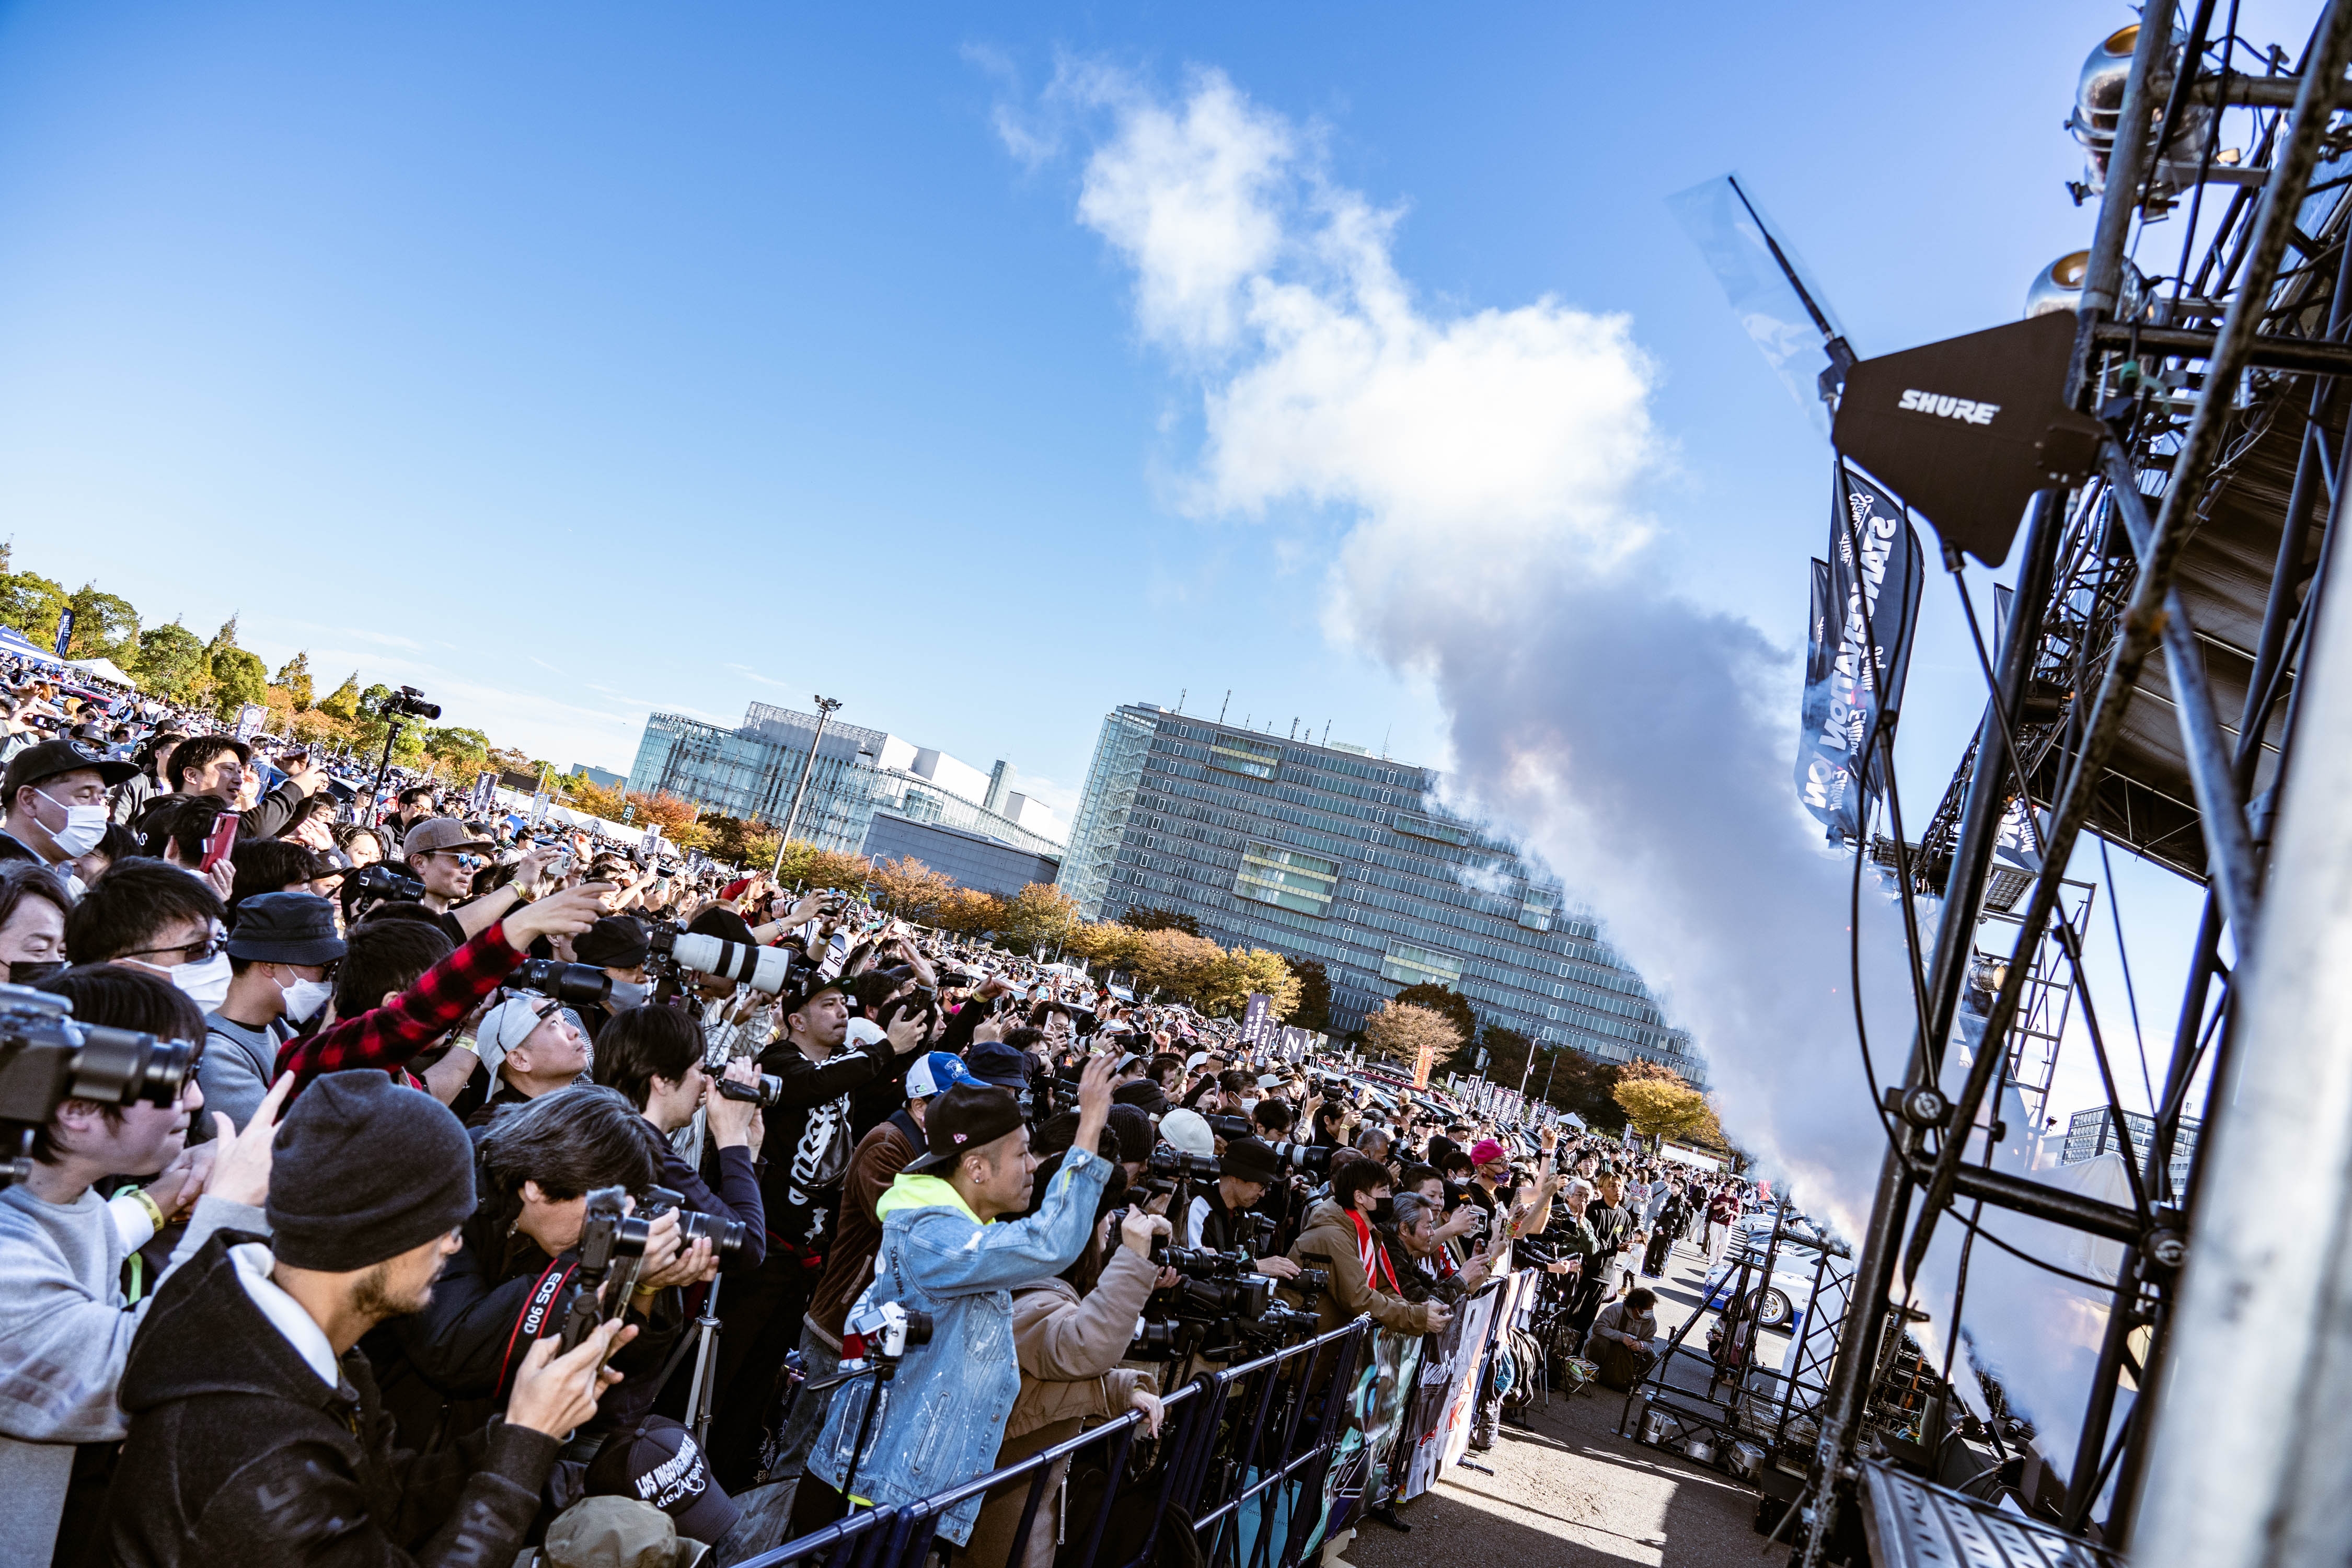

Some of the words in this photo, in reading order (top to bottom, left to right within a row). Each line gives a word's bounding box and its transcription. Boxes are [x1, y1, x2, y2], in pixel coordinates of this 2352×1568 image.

[1898, 388, 1998, 425] SHURE
[622, 805, 633, 819] 出口
[890, 1246, 905, 1298] SOMETHING
[536, 1272, 563, 1305] EOS
[523, 1306, 544, 1335] 90D
[635, 1471, 658, 1500] LOS
[1245, 1507, 1288, 1527] TOMOLAN
